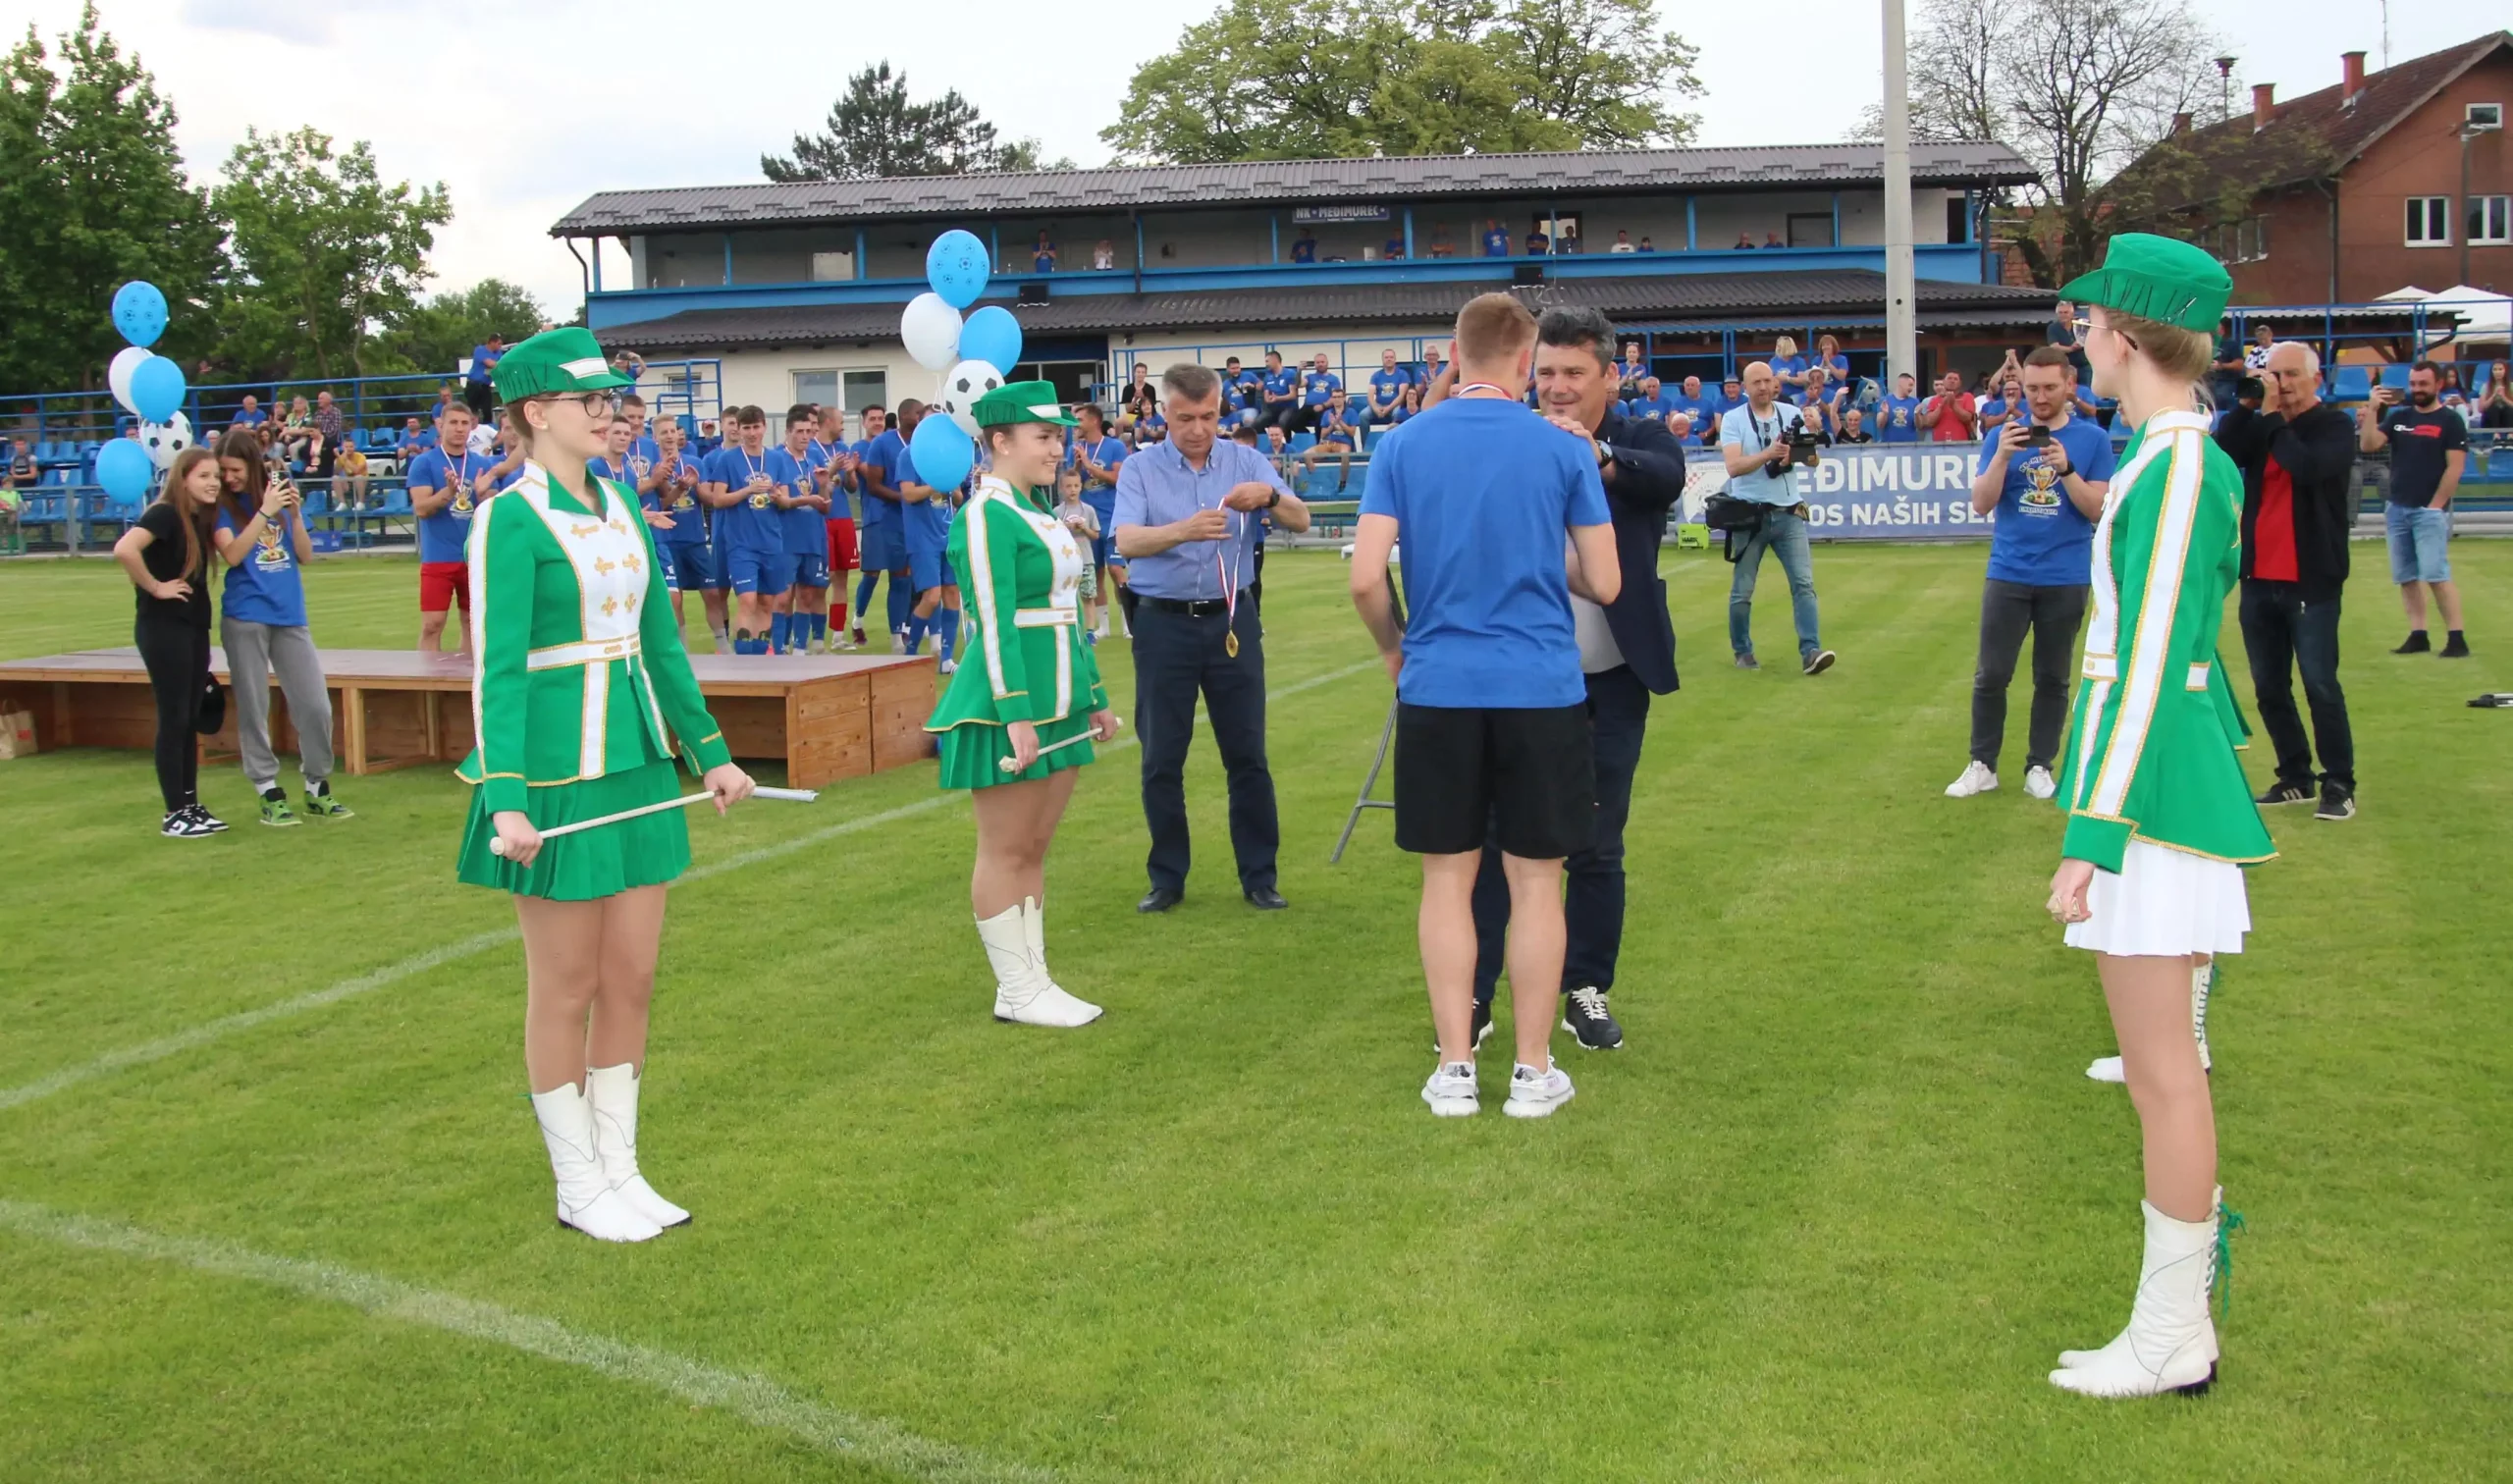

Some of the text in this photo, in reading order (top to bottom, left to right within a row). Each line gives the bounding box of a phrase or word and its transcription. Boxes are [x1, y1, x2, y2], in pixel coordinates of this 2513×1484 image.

[1296, 207, 1311, 219] NK
[1803, 504, 1845, 527] OS
[1851, 495, 1941, 526] NAŠIH
